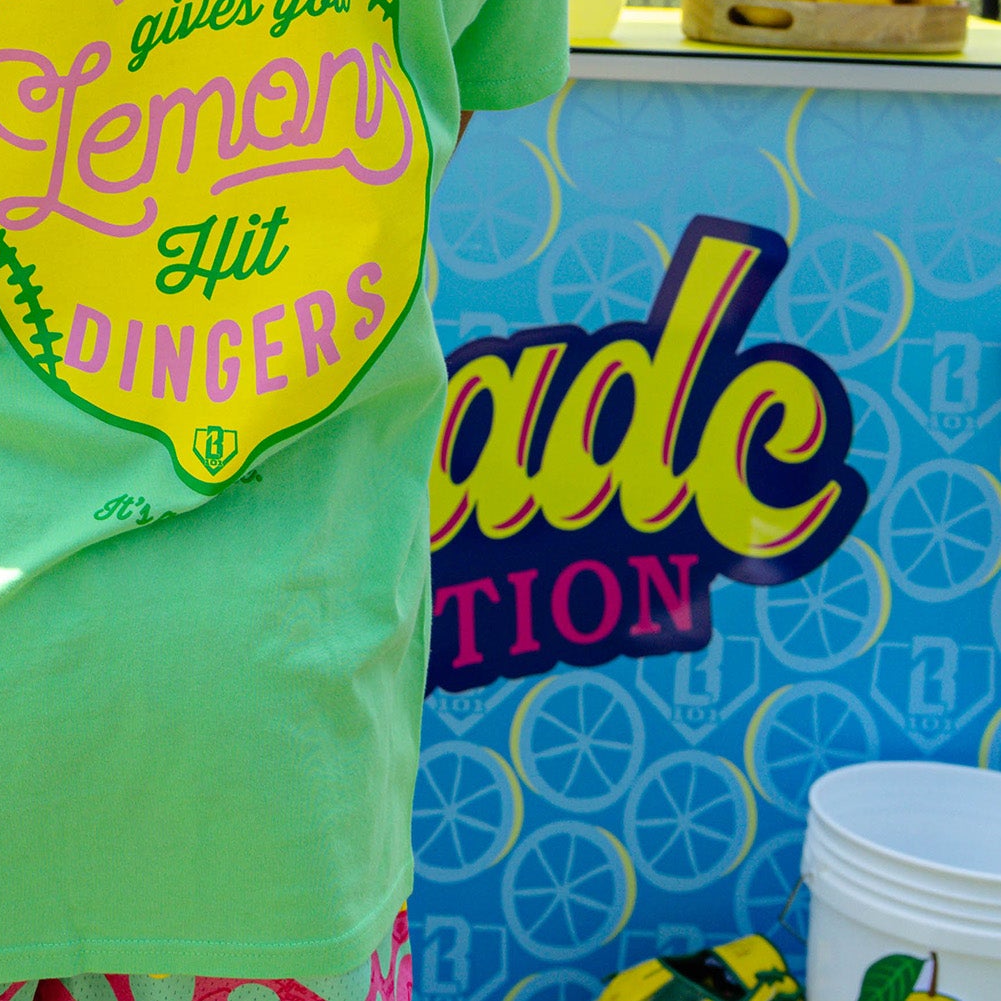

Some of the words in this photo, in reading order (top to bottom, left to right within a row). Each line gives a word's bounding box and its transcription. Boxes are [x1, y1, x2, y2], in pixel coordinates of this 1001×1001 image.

[155, 205, 290, 301] Hit
[63, 261, 386, 403] DINGERS
[93, 493, 153, 525] It's
